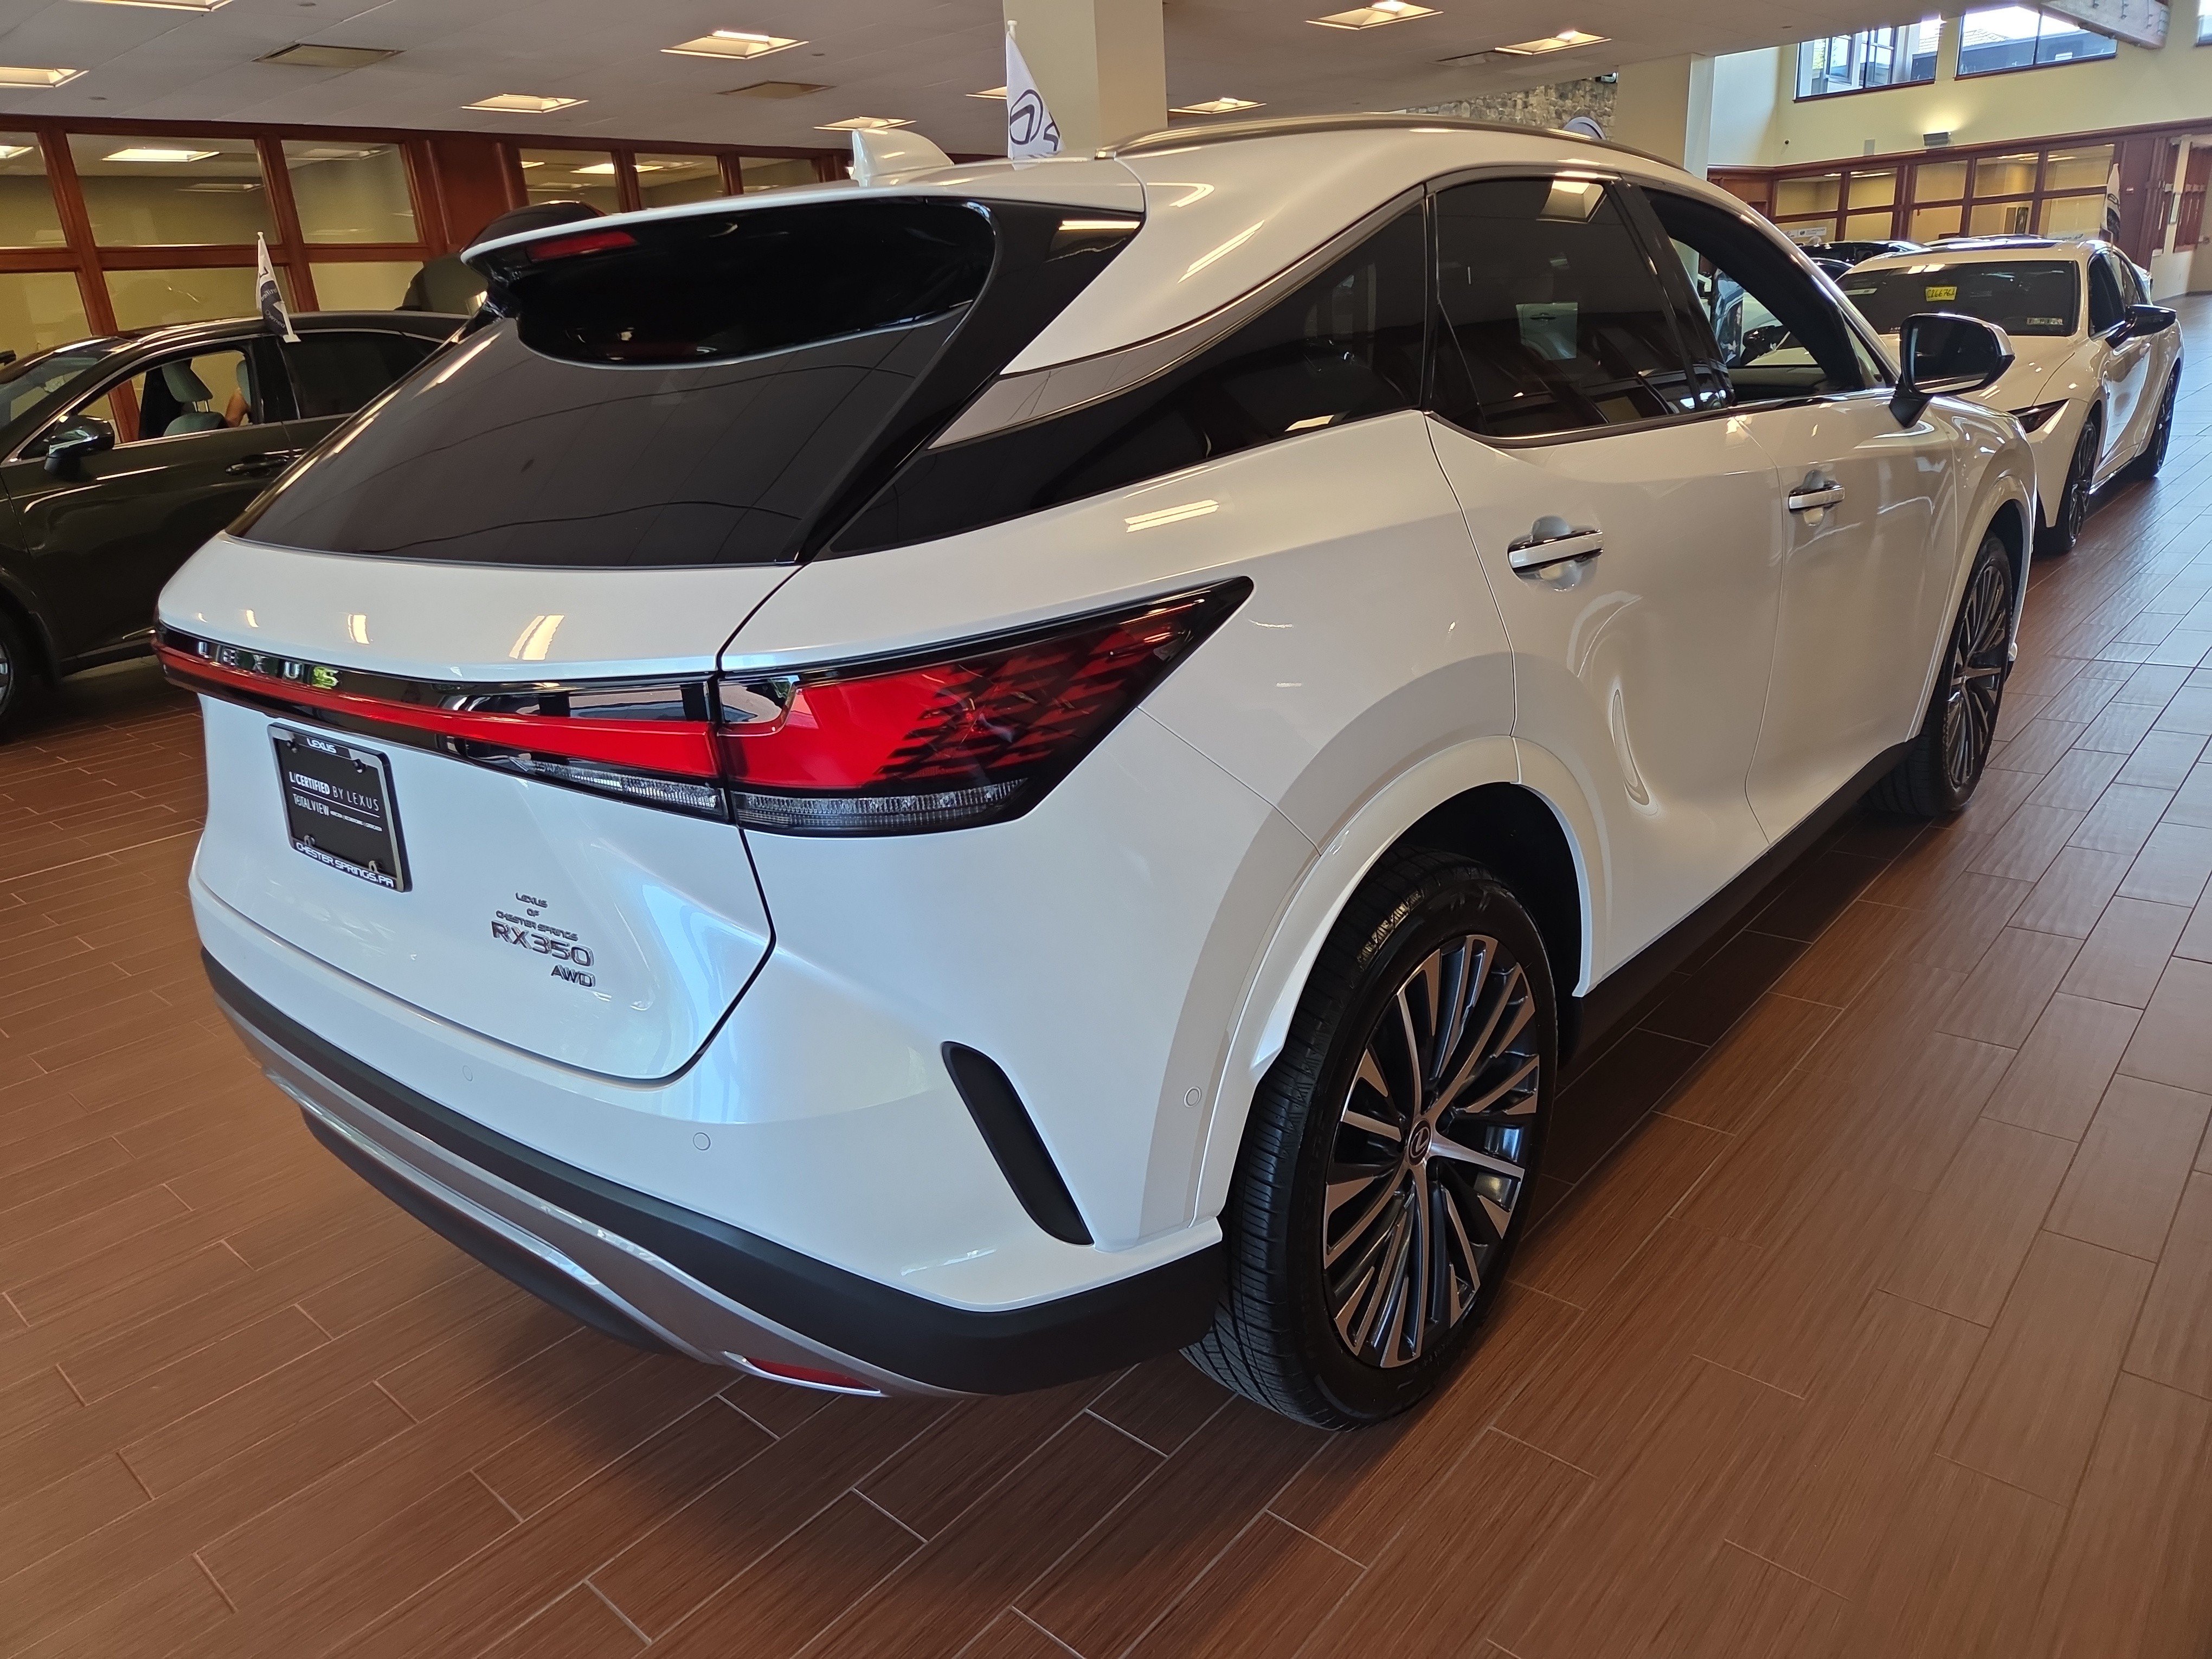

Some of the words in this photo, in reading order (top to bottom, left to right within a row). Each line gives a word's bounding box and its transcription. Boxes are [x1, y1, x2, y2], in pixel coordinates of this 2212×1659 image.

[198, 641, 339, 690] LEXUS
[306, 737, 337, 754] LEXUS
[332, 786, 343, 799] BY
[346, 790, 379, 811] LEXUS
[296, 842, 334, 866] CHESTER
[515, 892, 548, 908] LEXUS
[496, 910, 537, 930] CHESTER
[526, 908, 540, 917] OF
[551, 964, 596, 988] AWD
